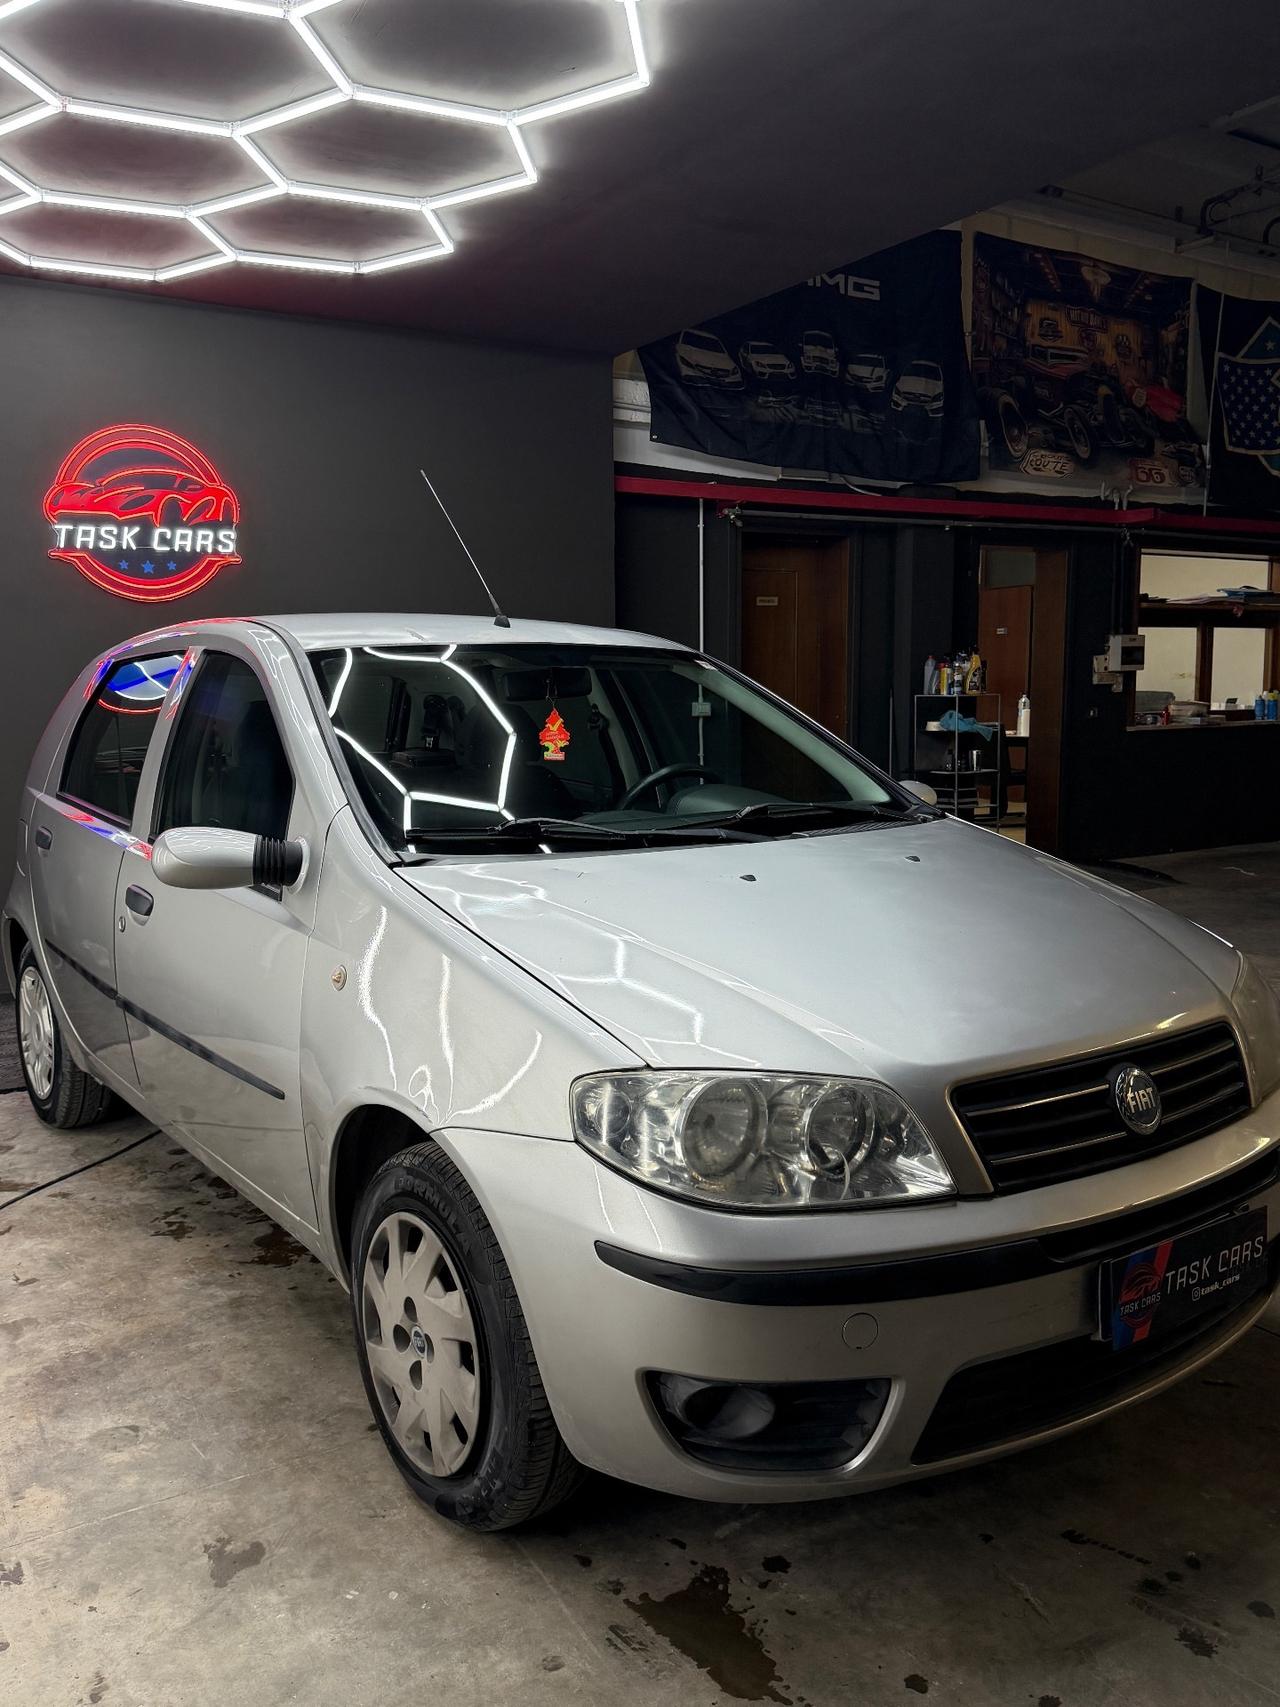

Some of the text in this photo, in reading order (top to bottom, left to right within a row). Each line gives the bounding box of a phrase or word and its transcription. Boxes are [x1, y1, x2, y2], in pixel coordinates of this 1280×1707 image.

[807, 272, 881, 302] MG
[54, 525, 236, 554] TASK CARS
[1126, 1086, 1156, 1114] FIAT
[1165, 1235, 1265, 1295] TASK CARS
[1200, 1273, 1241, 1296] task_cars
[1119, 1292, 1162, 1317] TASK CARS
